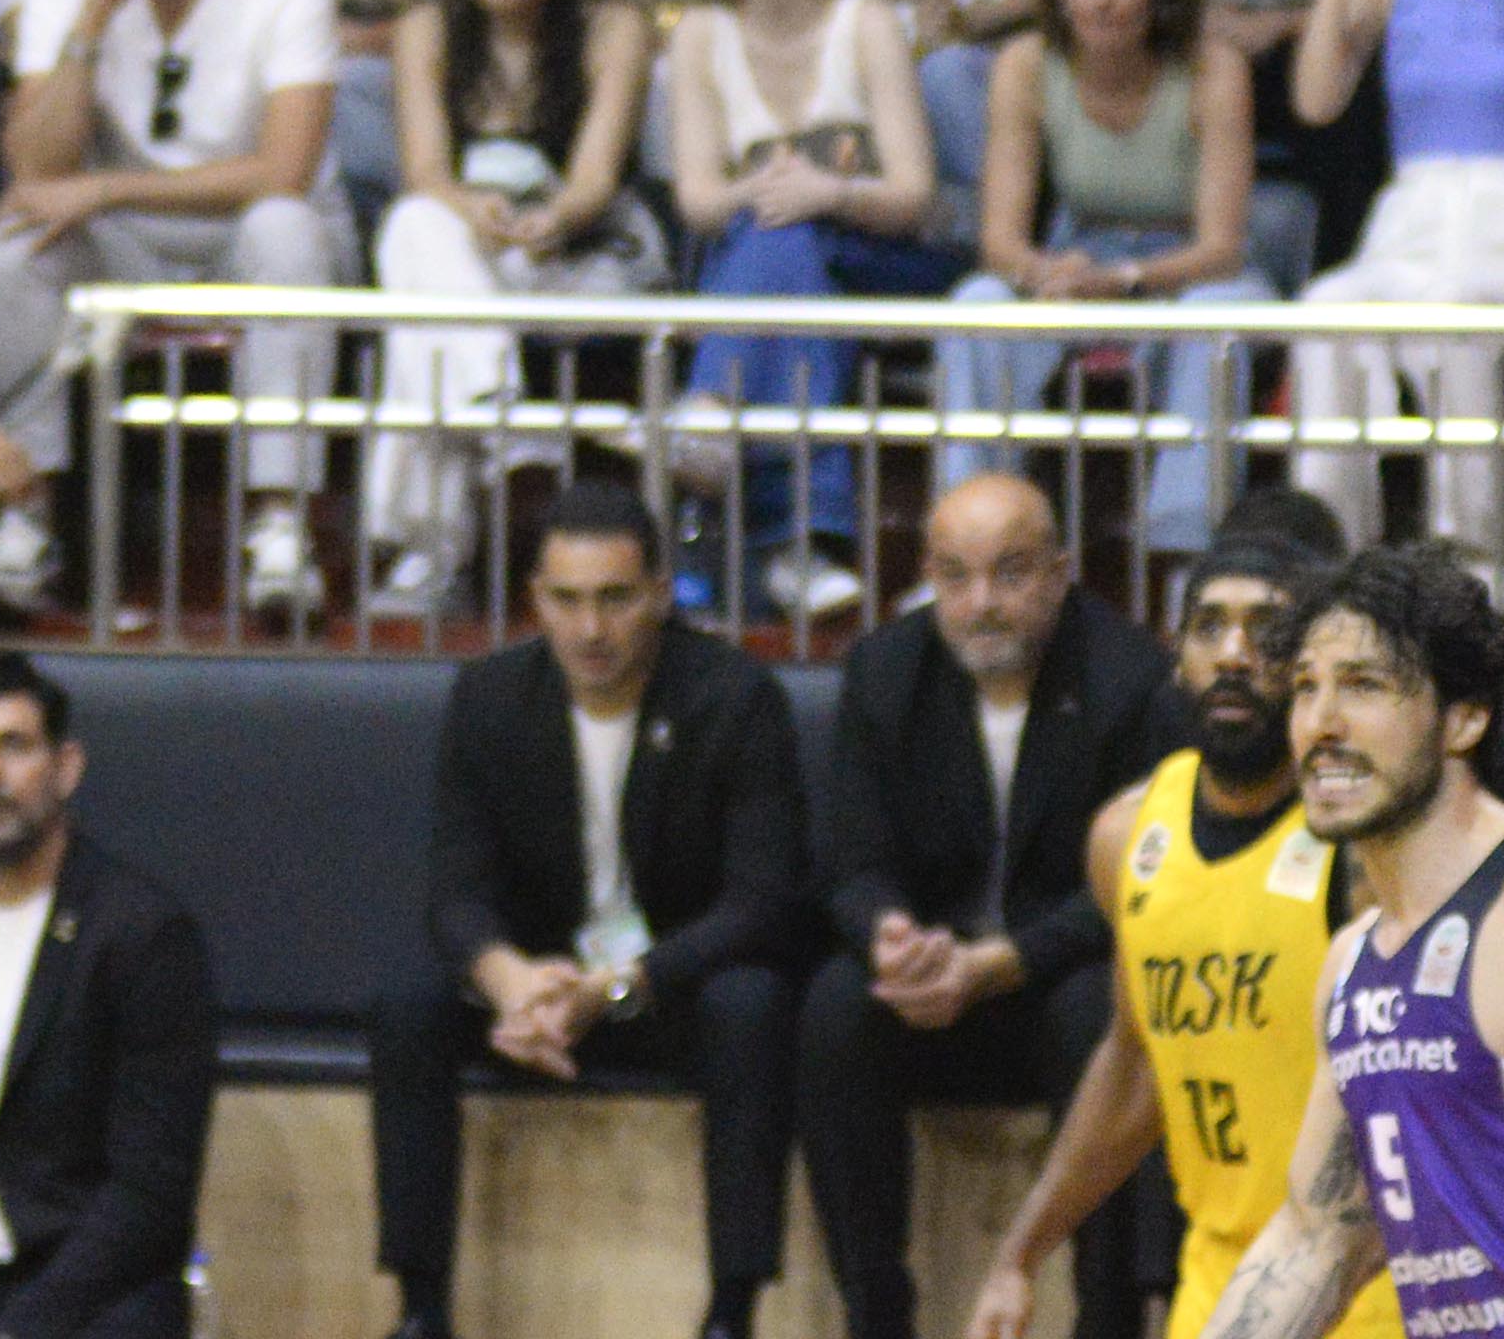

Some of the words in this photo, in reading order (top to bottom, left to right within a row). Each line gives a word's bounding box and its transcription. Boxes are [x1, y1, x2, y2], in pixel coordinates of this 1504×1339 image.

[1143, 952, 1277, 1038] MSK
[1181, 1078, 1249, 1165] 12
[1367, 1113, 1415, 1222] 5
